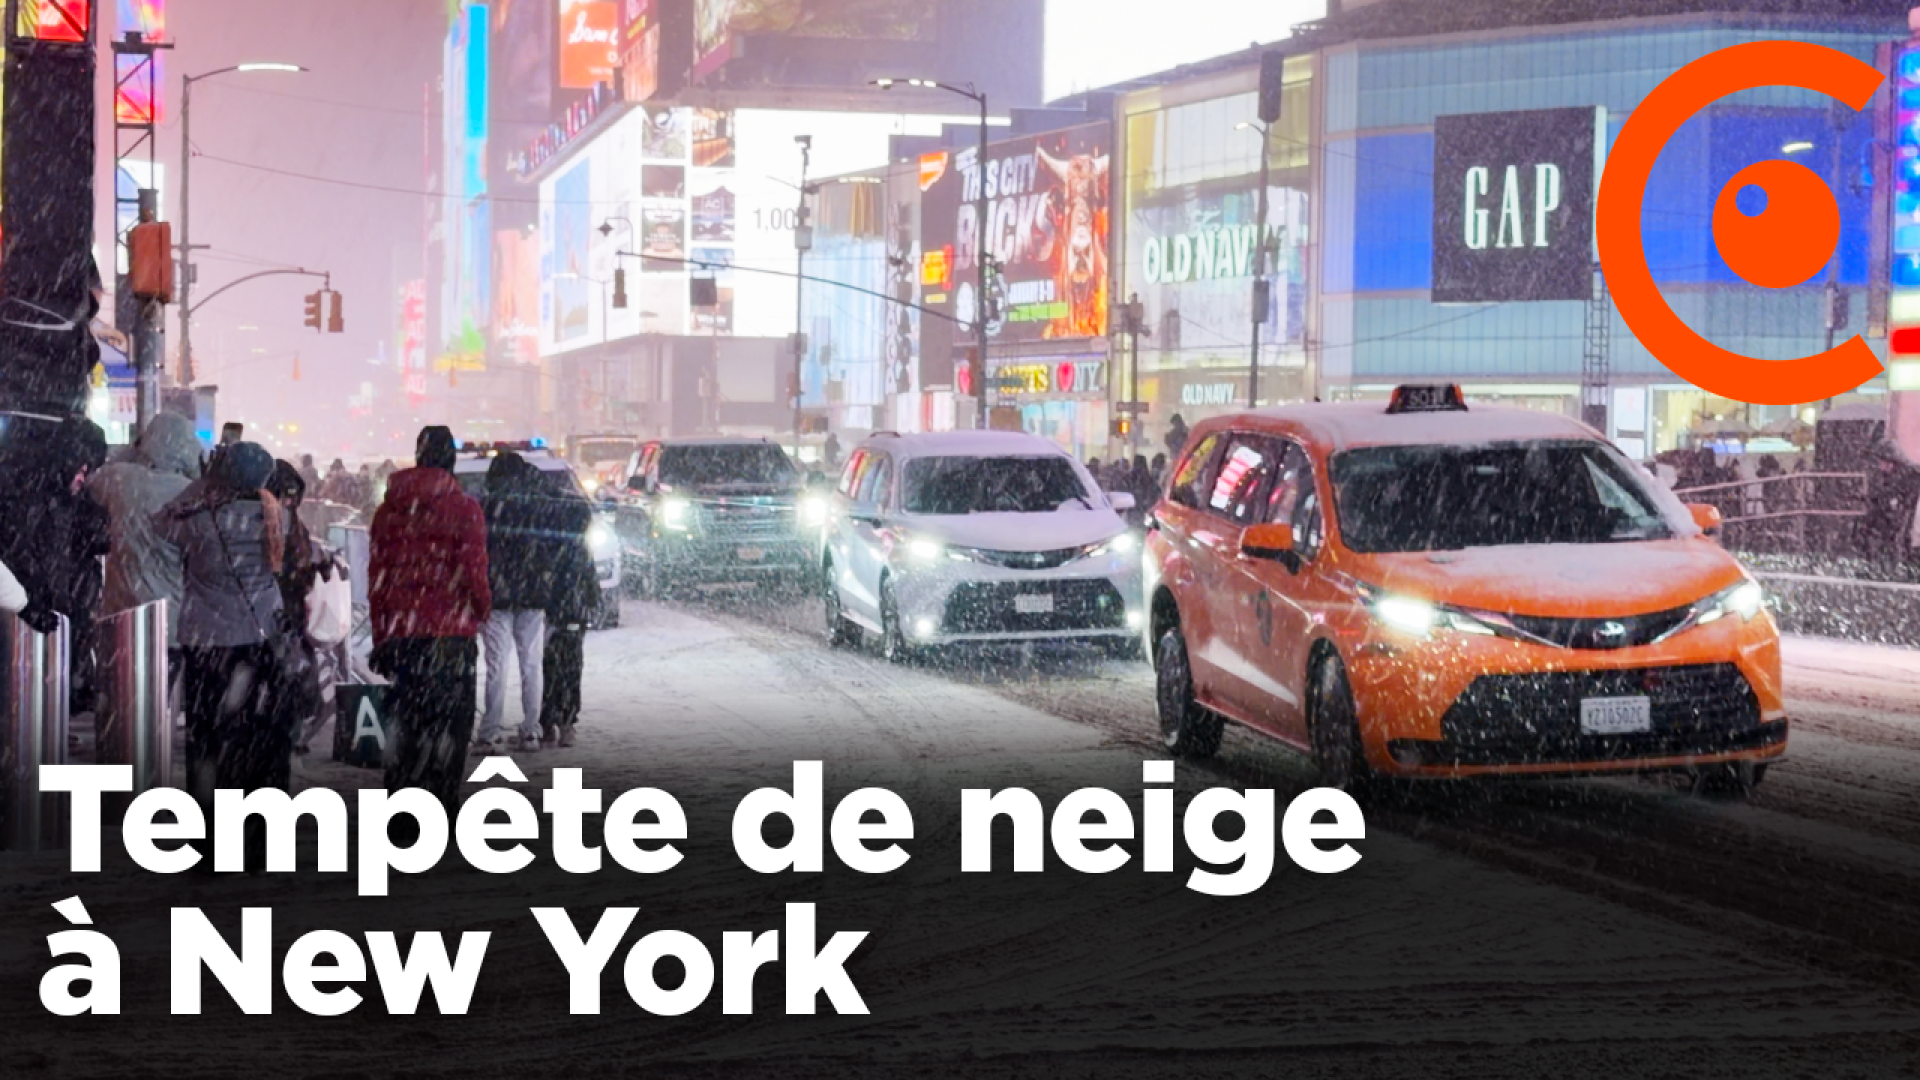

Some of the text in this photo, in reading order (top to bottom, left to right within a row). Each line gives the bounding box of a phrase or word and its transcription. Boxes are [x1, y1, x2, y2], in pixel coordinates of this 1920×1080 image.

[961, 159, 1000, 202] THS
[1000, 154, 1039, 197] CITY
[1463, 162, 1560, 250] GAP
[1142, 233, 1192, 285] OLD
[1181, 383, 1235, 406] OLD NAVY
[350, 695, 386, 751] A
